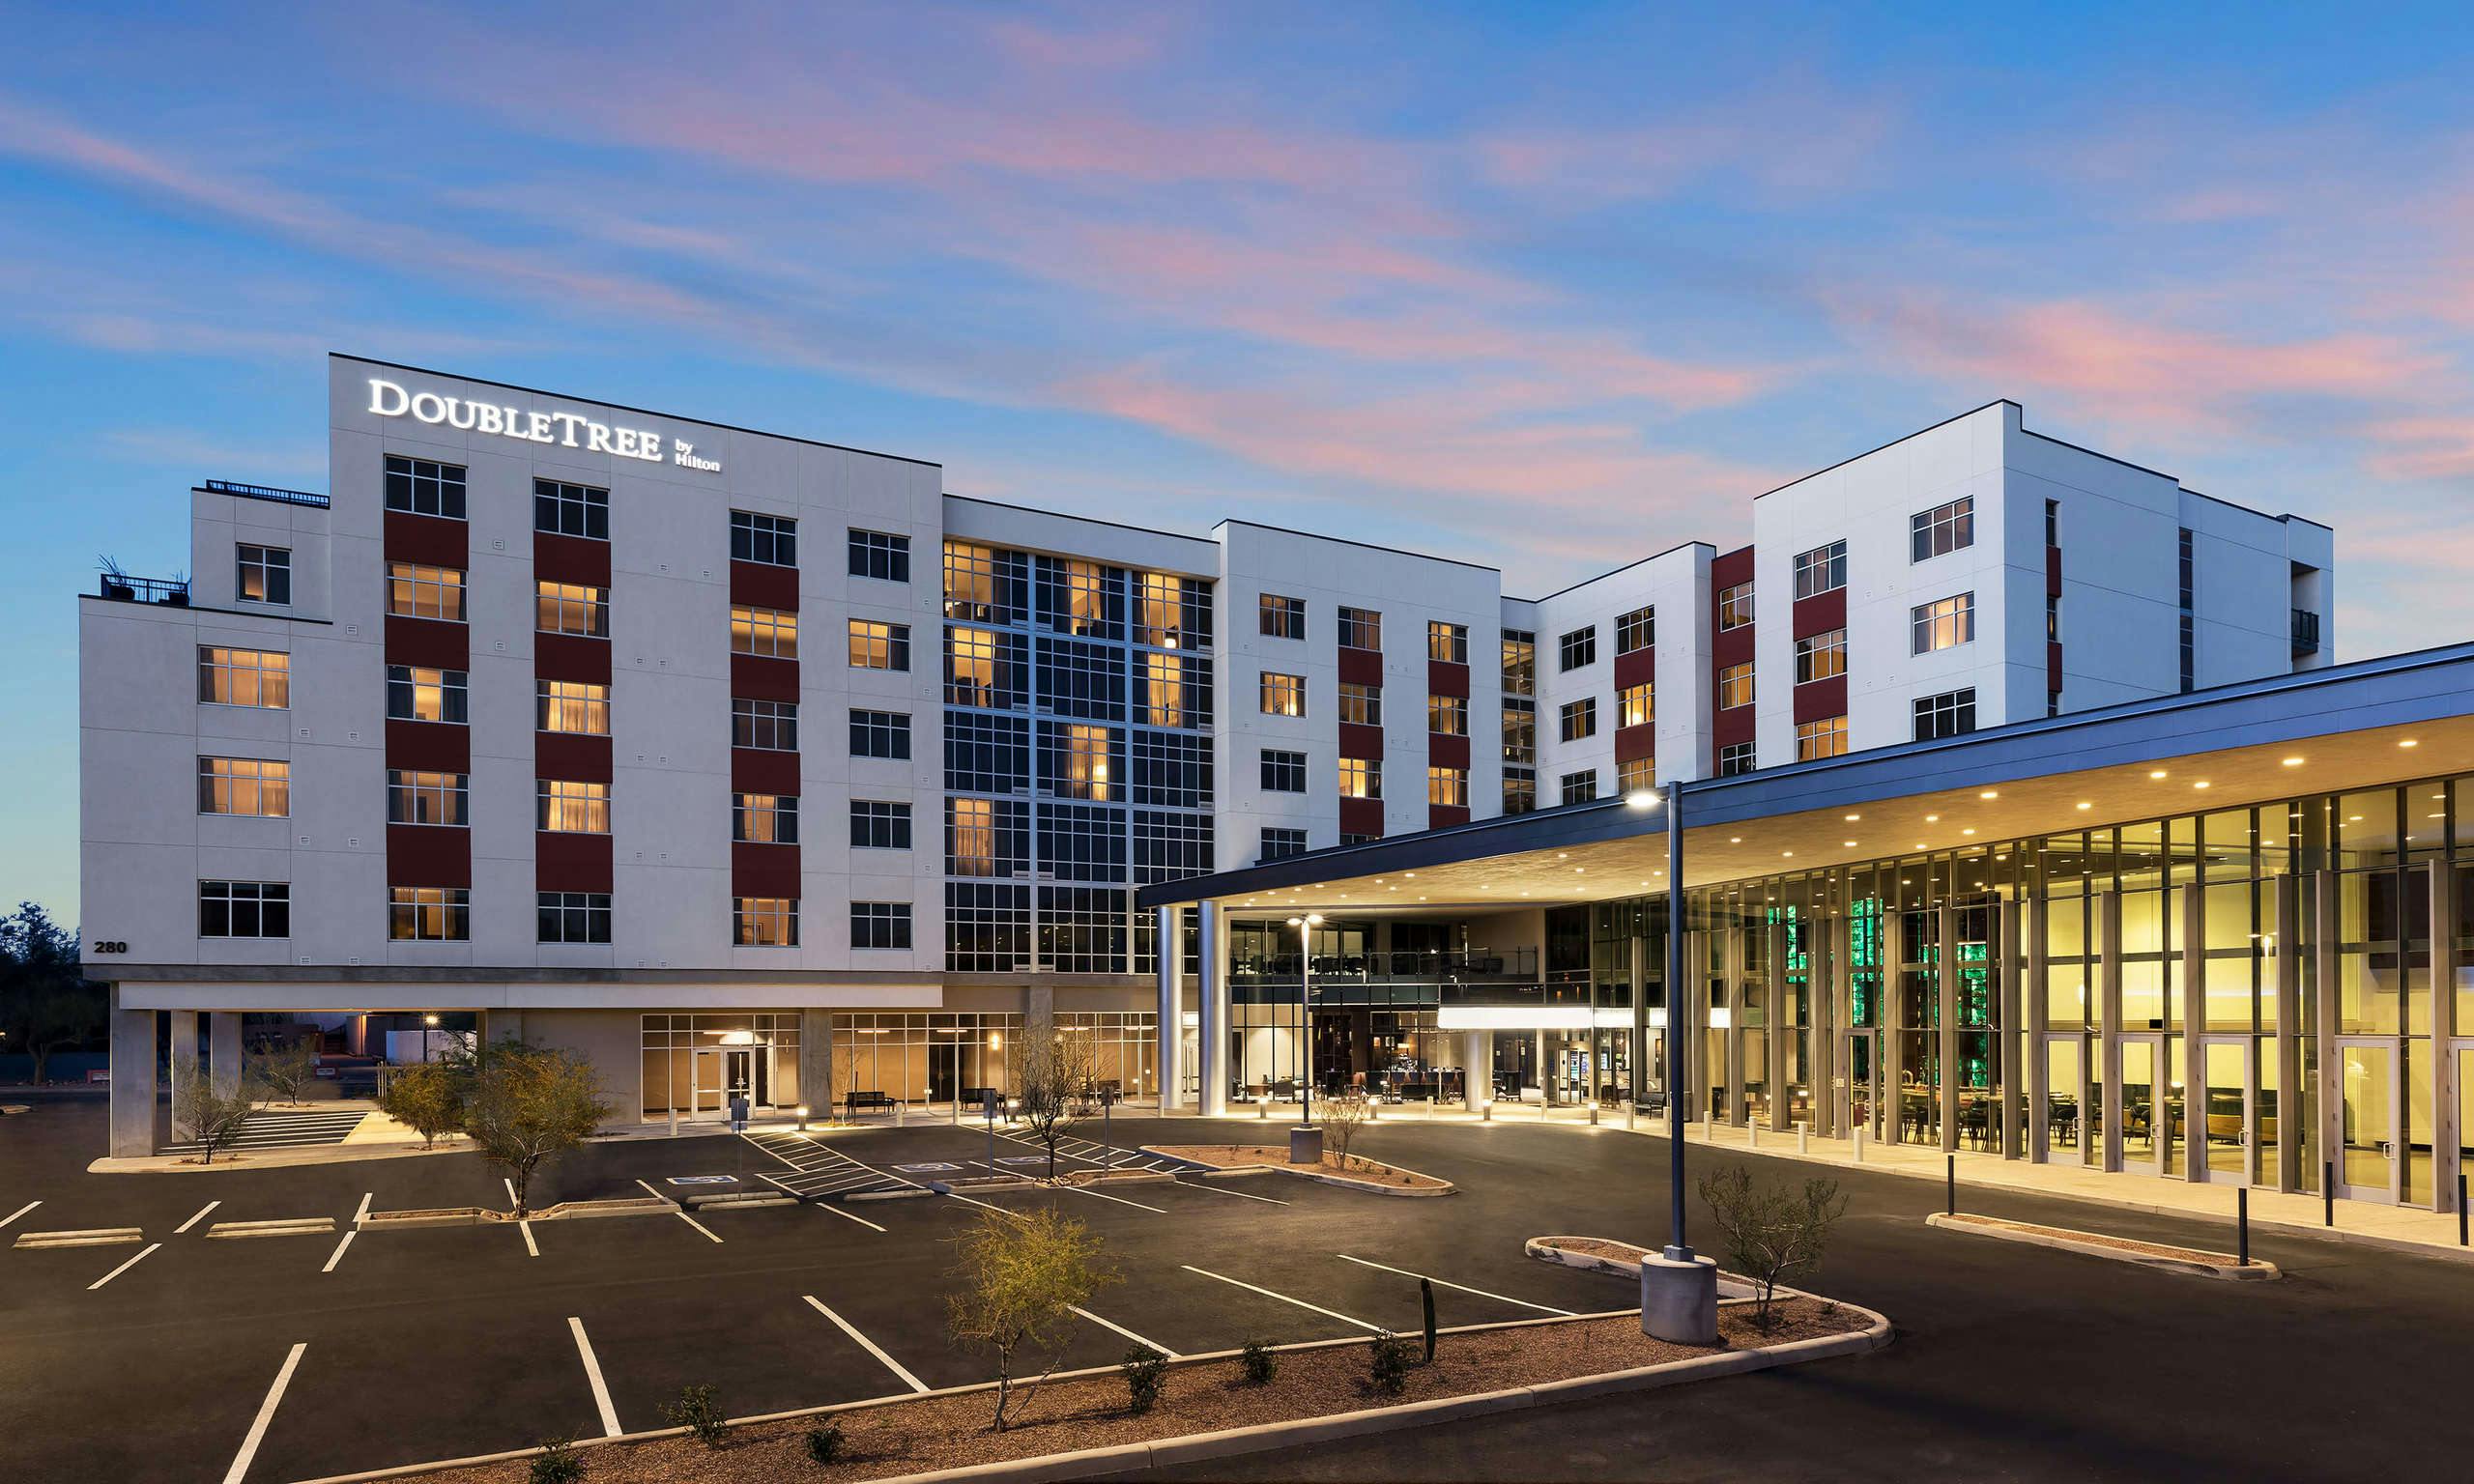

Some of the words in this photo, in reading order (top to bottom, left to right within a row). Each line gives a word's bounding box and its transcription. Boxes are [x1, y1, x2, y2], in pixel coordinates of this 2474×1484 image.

[368, 379, 663, 462] DOUBLETREE
[675, 439, 694, 455] by
[675, 453, 721, 472] Hilton
[94, 941, 128, 954] 280
